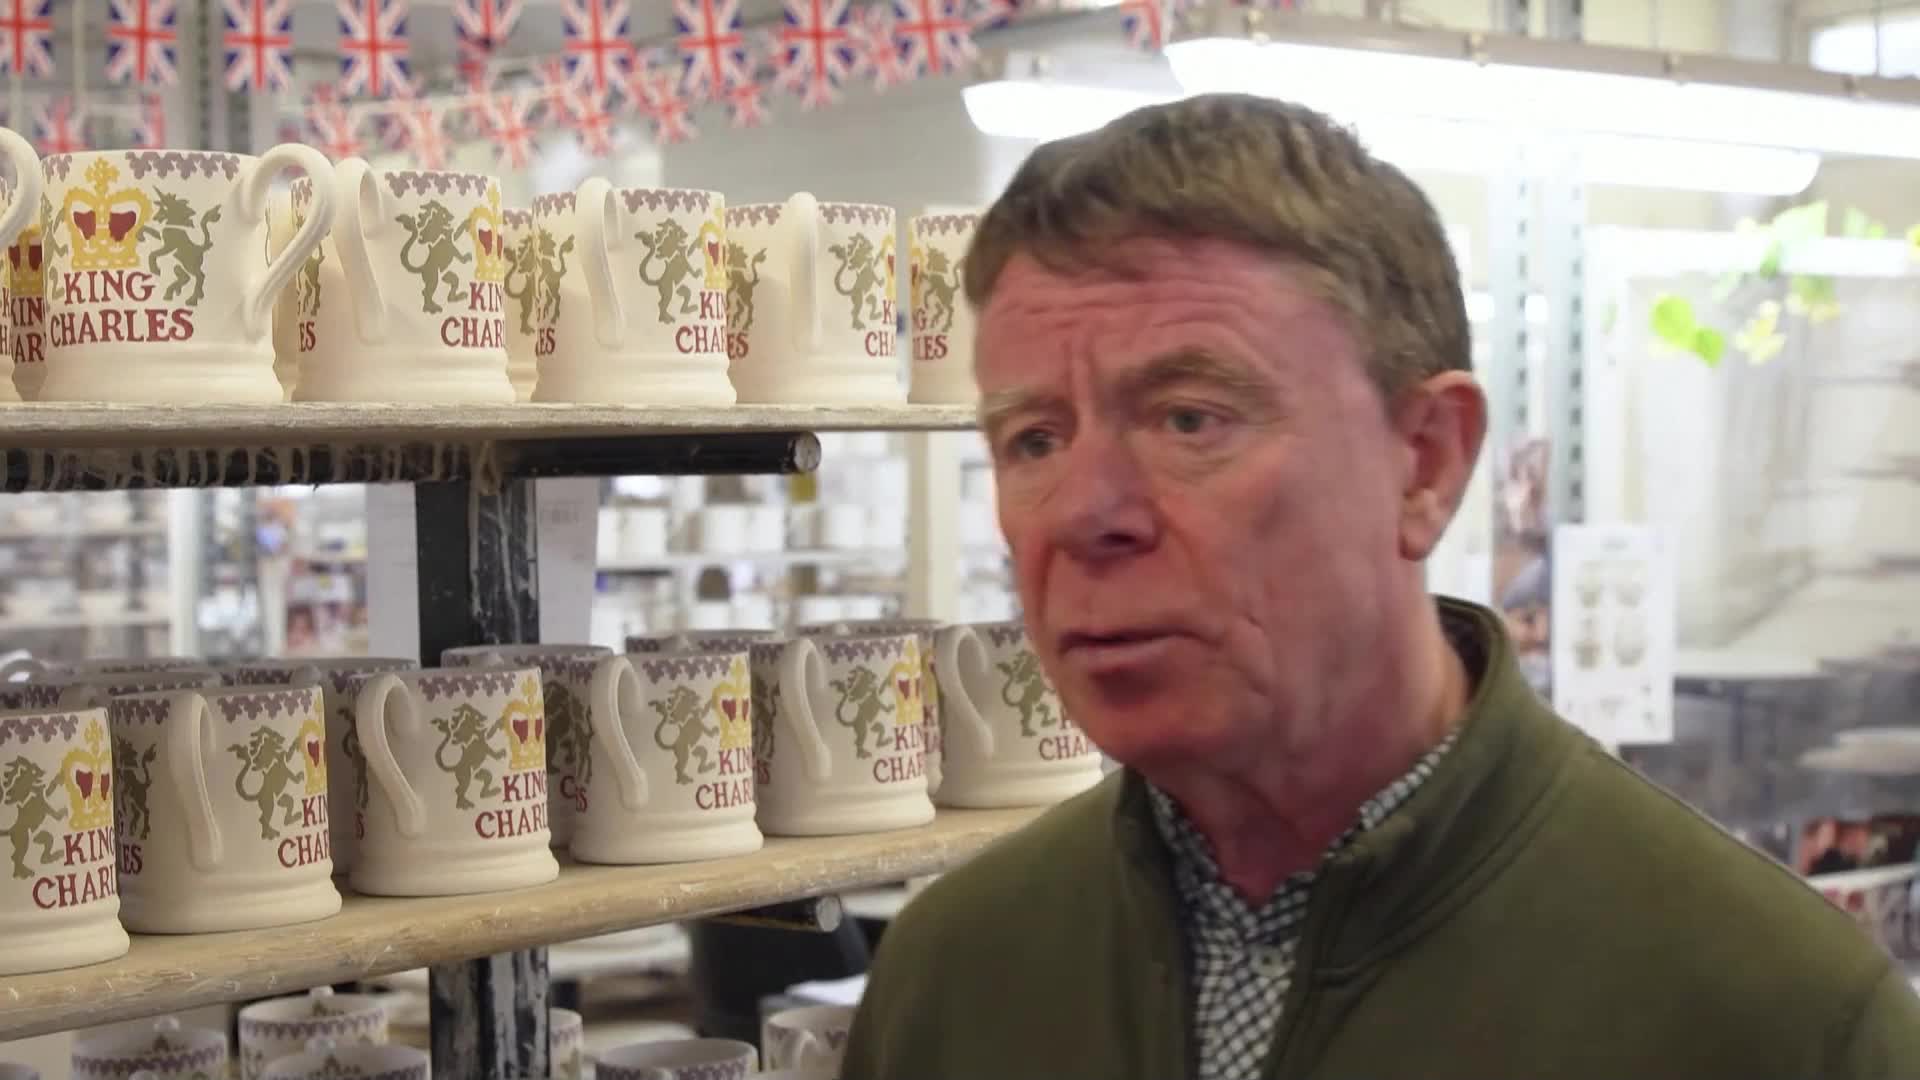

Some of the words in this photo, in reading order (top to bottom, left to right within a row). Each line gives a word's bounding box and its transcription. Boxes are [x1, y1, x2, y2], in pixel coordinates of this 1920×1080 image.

[64, 271, 156, 305] KING
[11, 296, 46, 327] KIN
[51, 308, 194, 348] CHARLES
